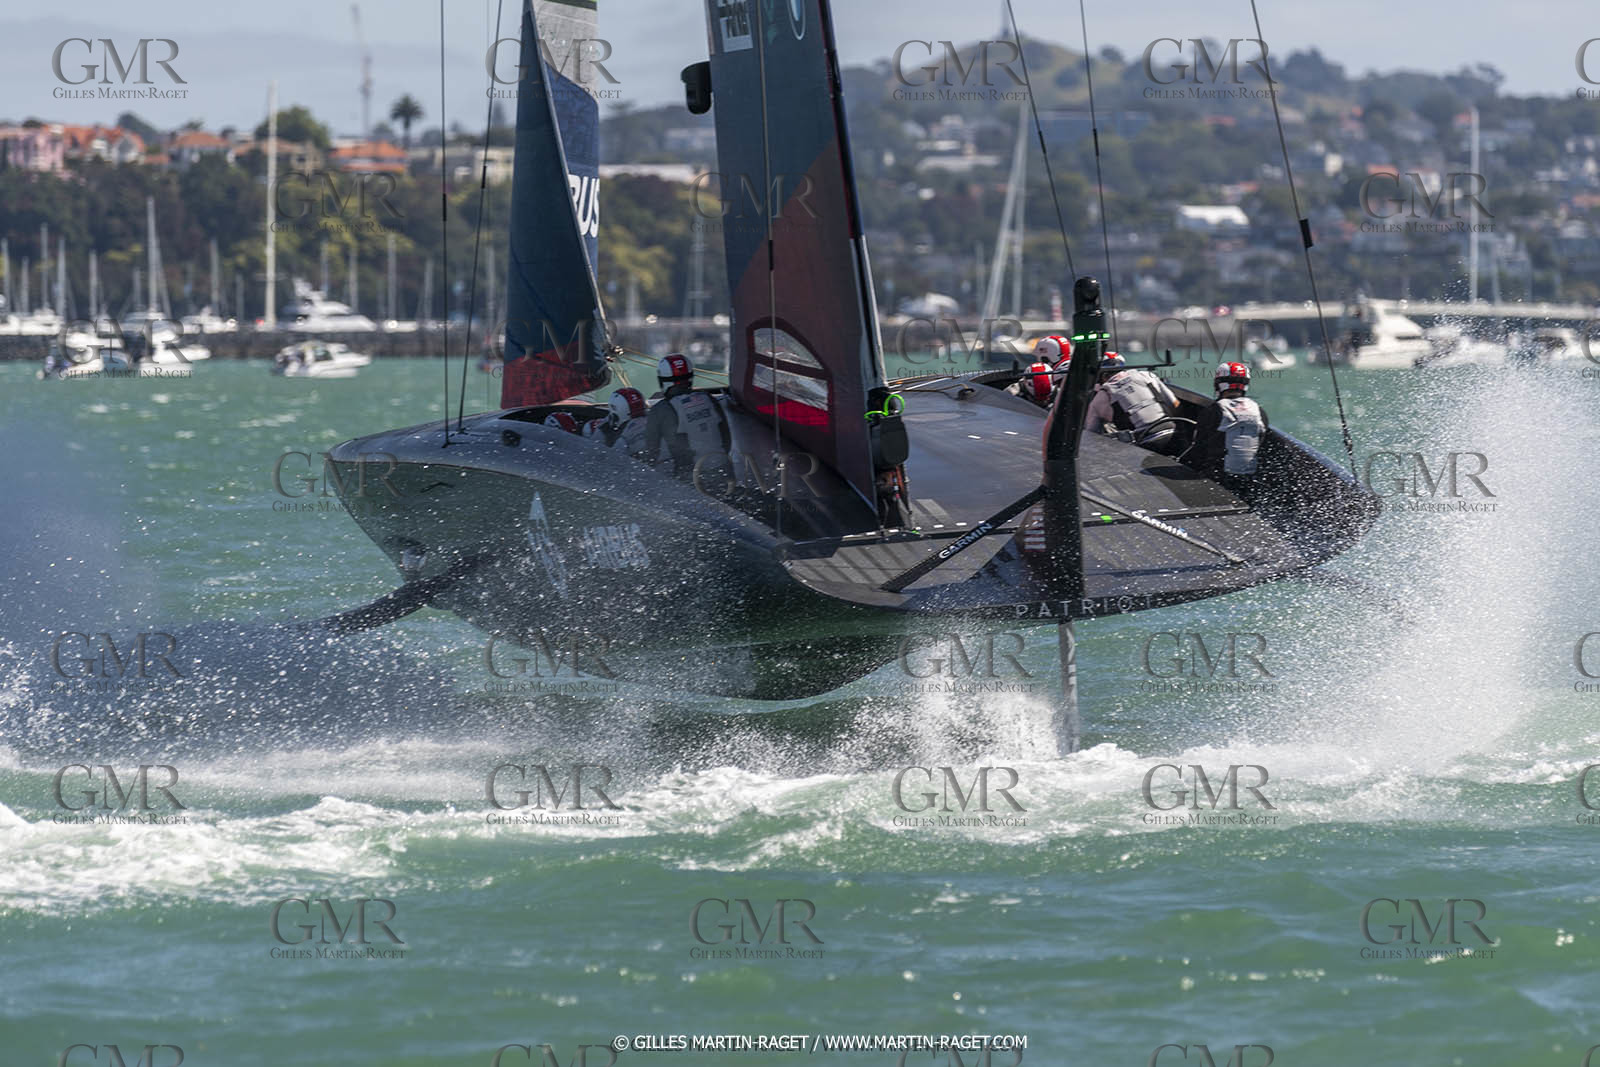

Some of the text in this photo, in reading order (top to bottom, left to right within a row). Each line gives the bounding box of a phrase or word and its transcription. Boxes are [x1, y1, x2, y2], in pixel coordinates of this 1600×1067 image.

[1131, 510, 1188, 538] GARMIN
[939, 522, 992, 559] GARMIN
[1015, 593, 1153, 619] PATRIOT
